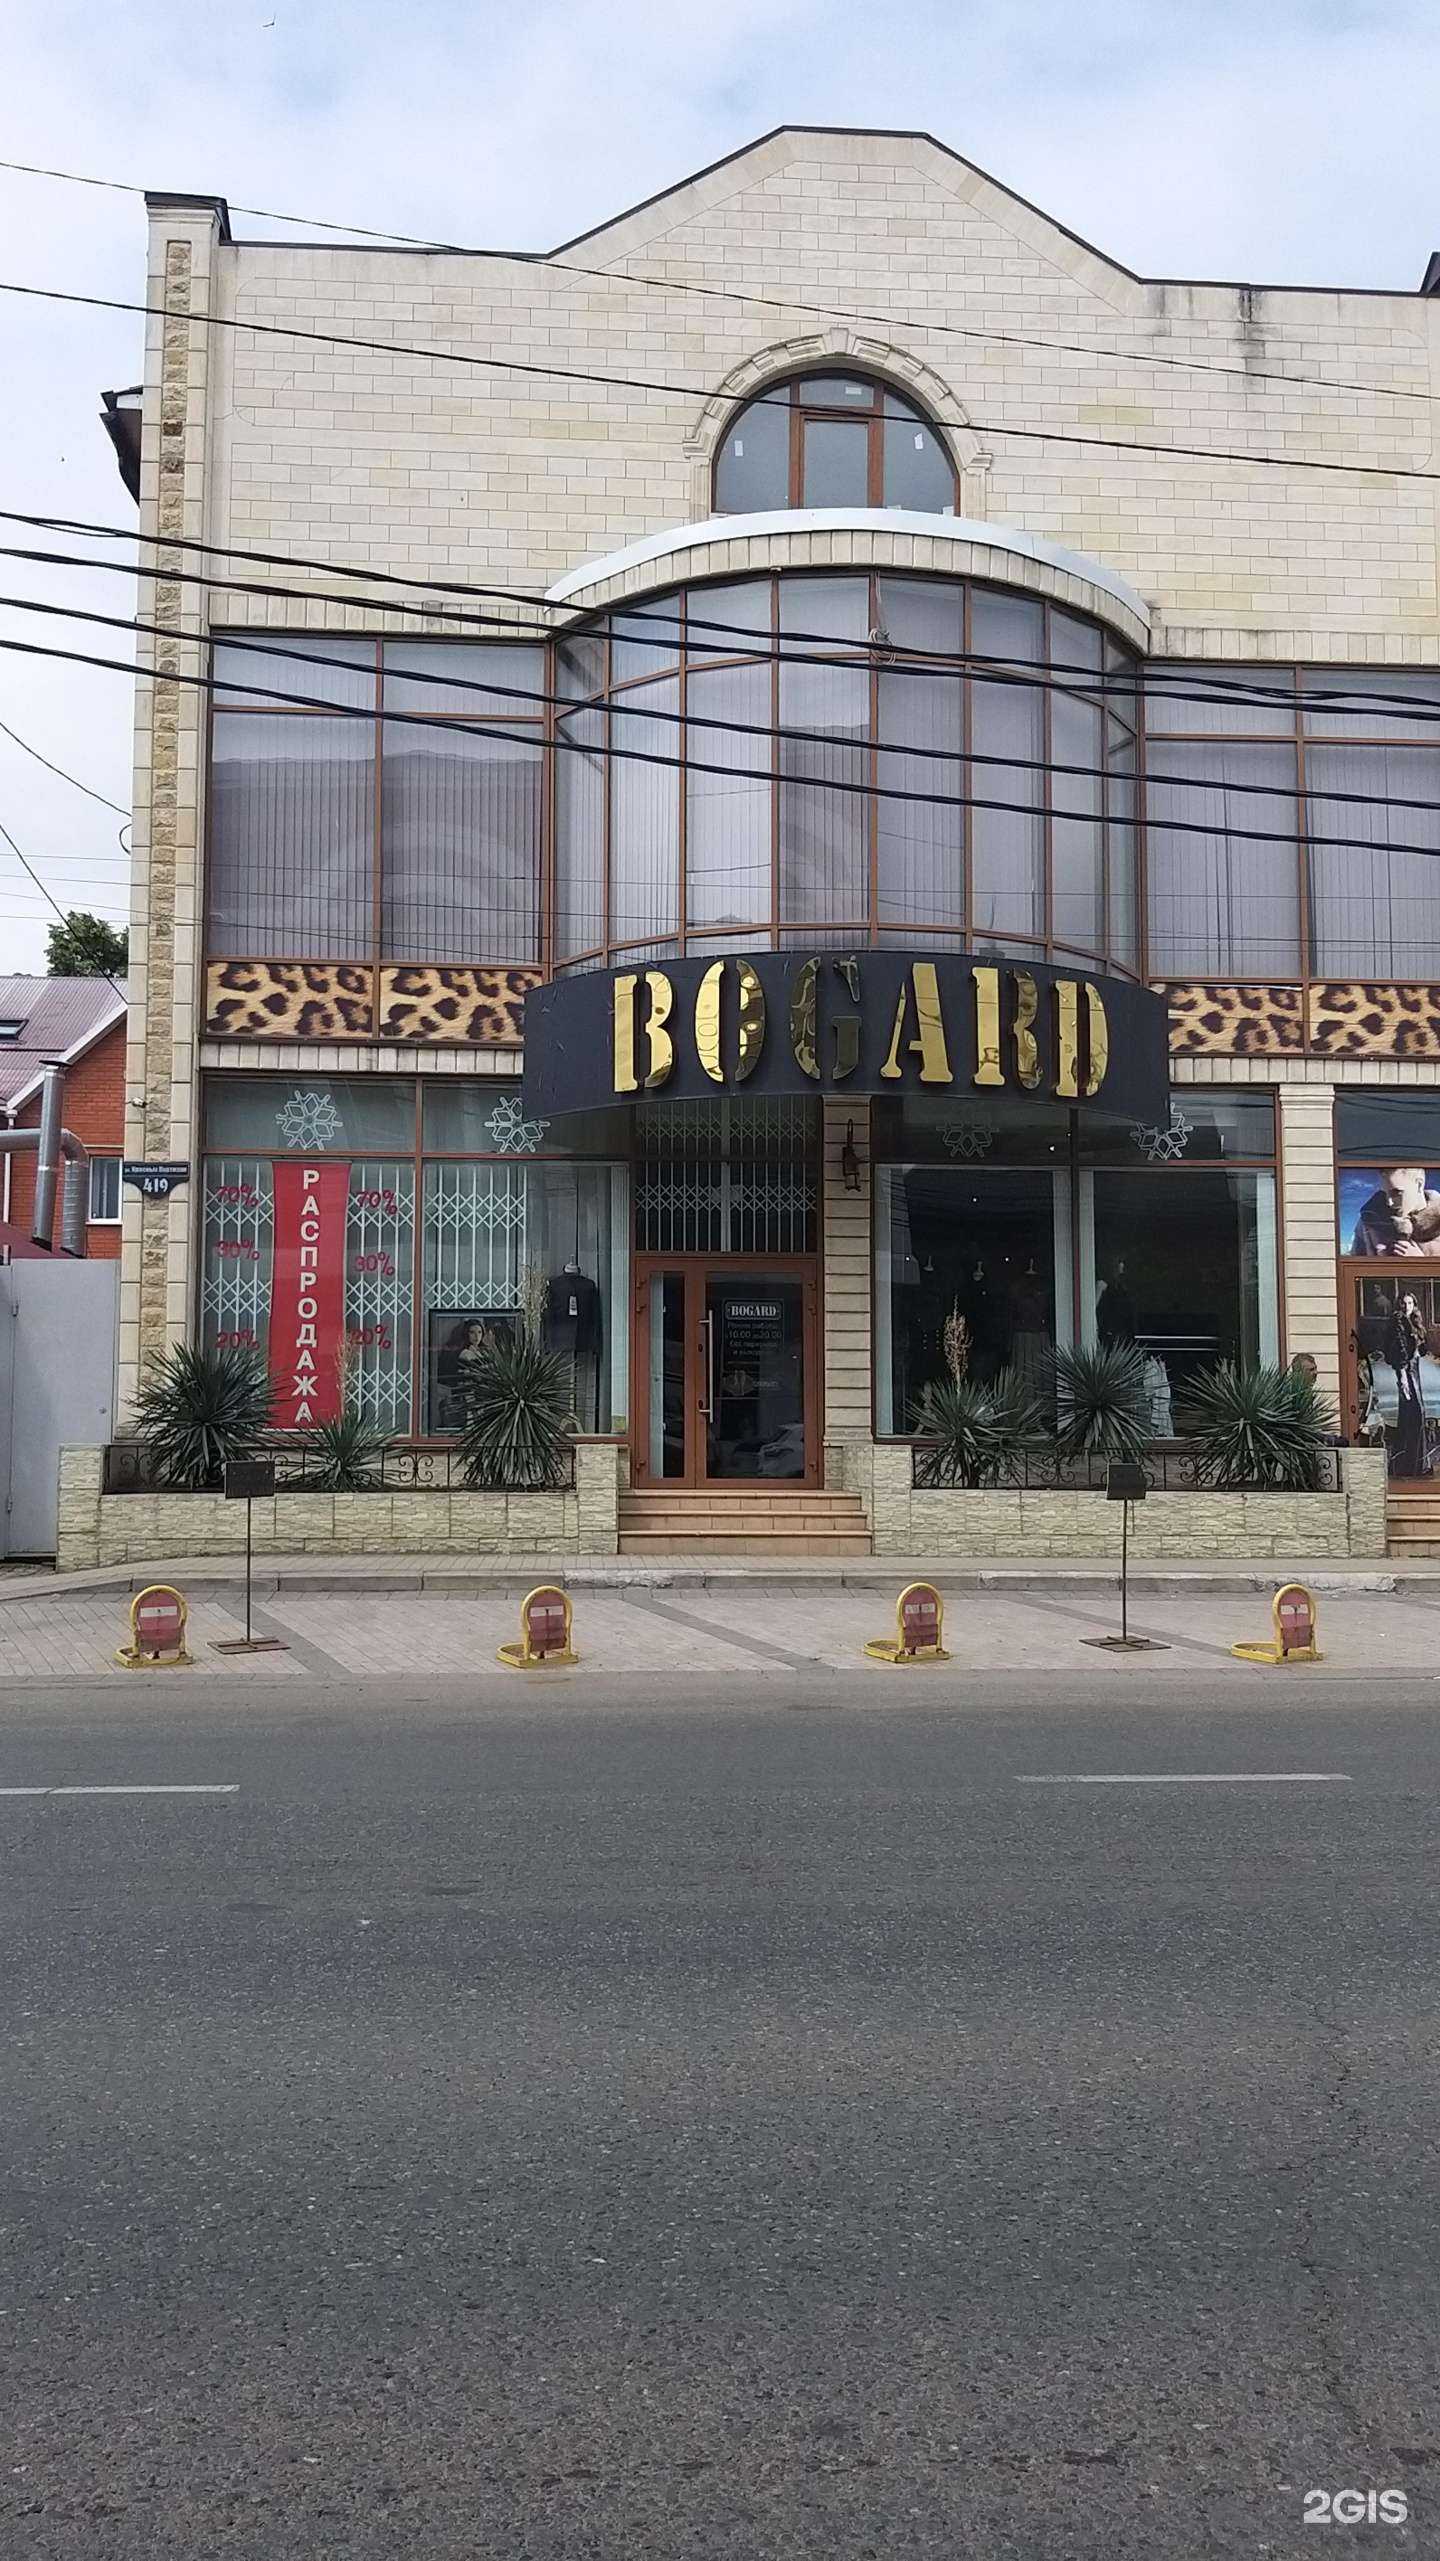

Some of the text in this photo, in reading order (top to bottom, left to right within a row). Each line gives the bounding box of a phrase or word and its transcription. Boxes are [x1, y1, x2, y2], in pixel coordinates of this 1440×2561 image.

[613, 956, 1109, 1098] BOGARD
[142, 1177, 169, 1192] 419
[217, 1184, 260, 1207] 70%
[356, 1189, 398, 1215] 70%
[354, 1251, 396, 1276] 30%
[291, 1169, 320, 1423] РАСПРОДАЖА
[731, 1305, 777, 1317] BOGARD
[215, 1328, 260, 1350] 20%
[348, 1324, 392, 1350] 20%
